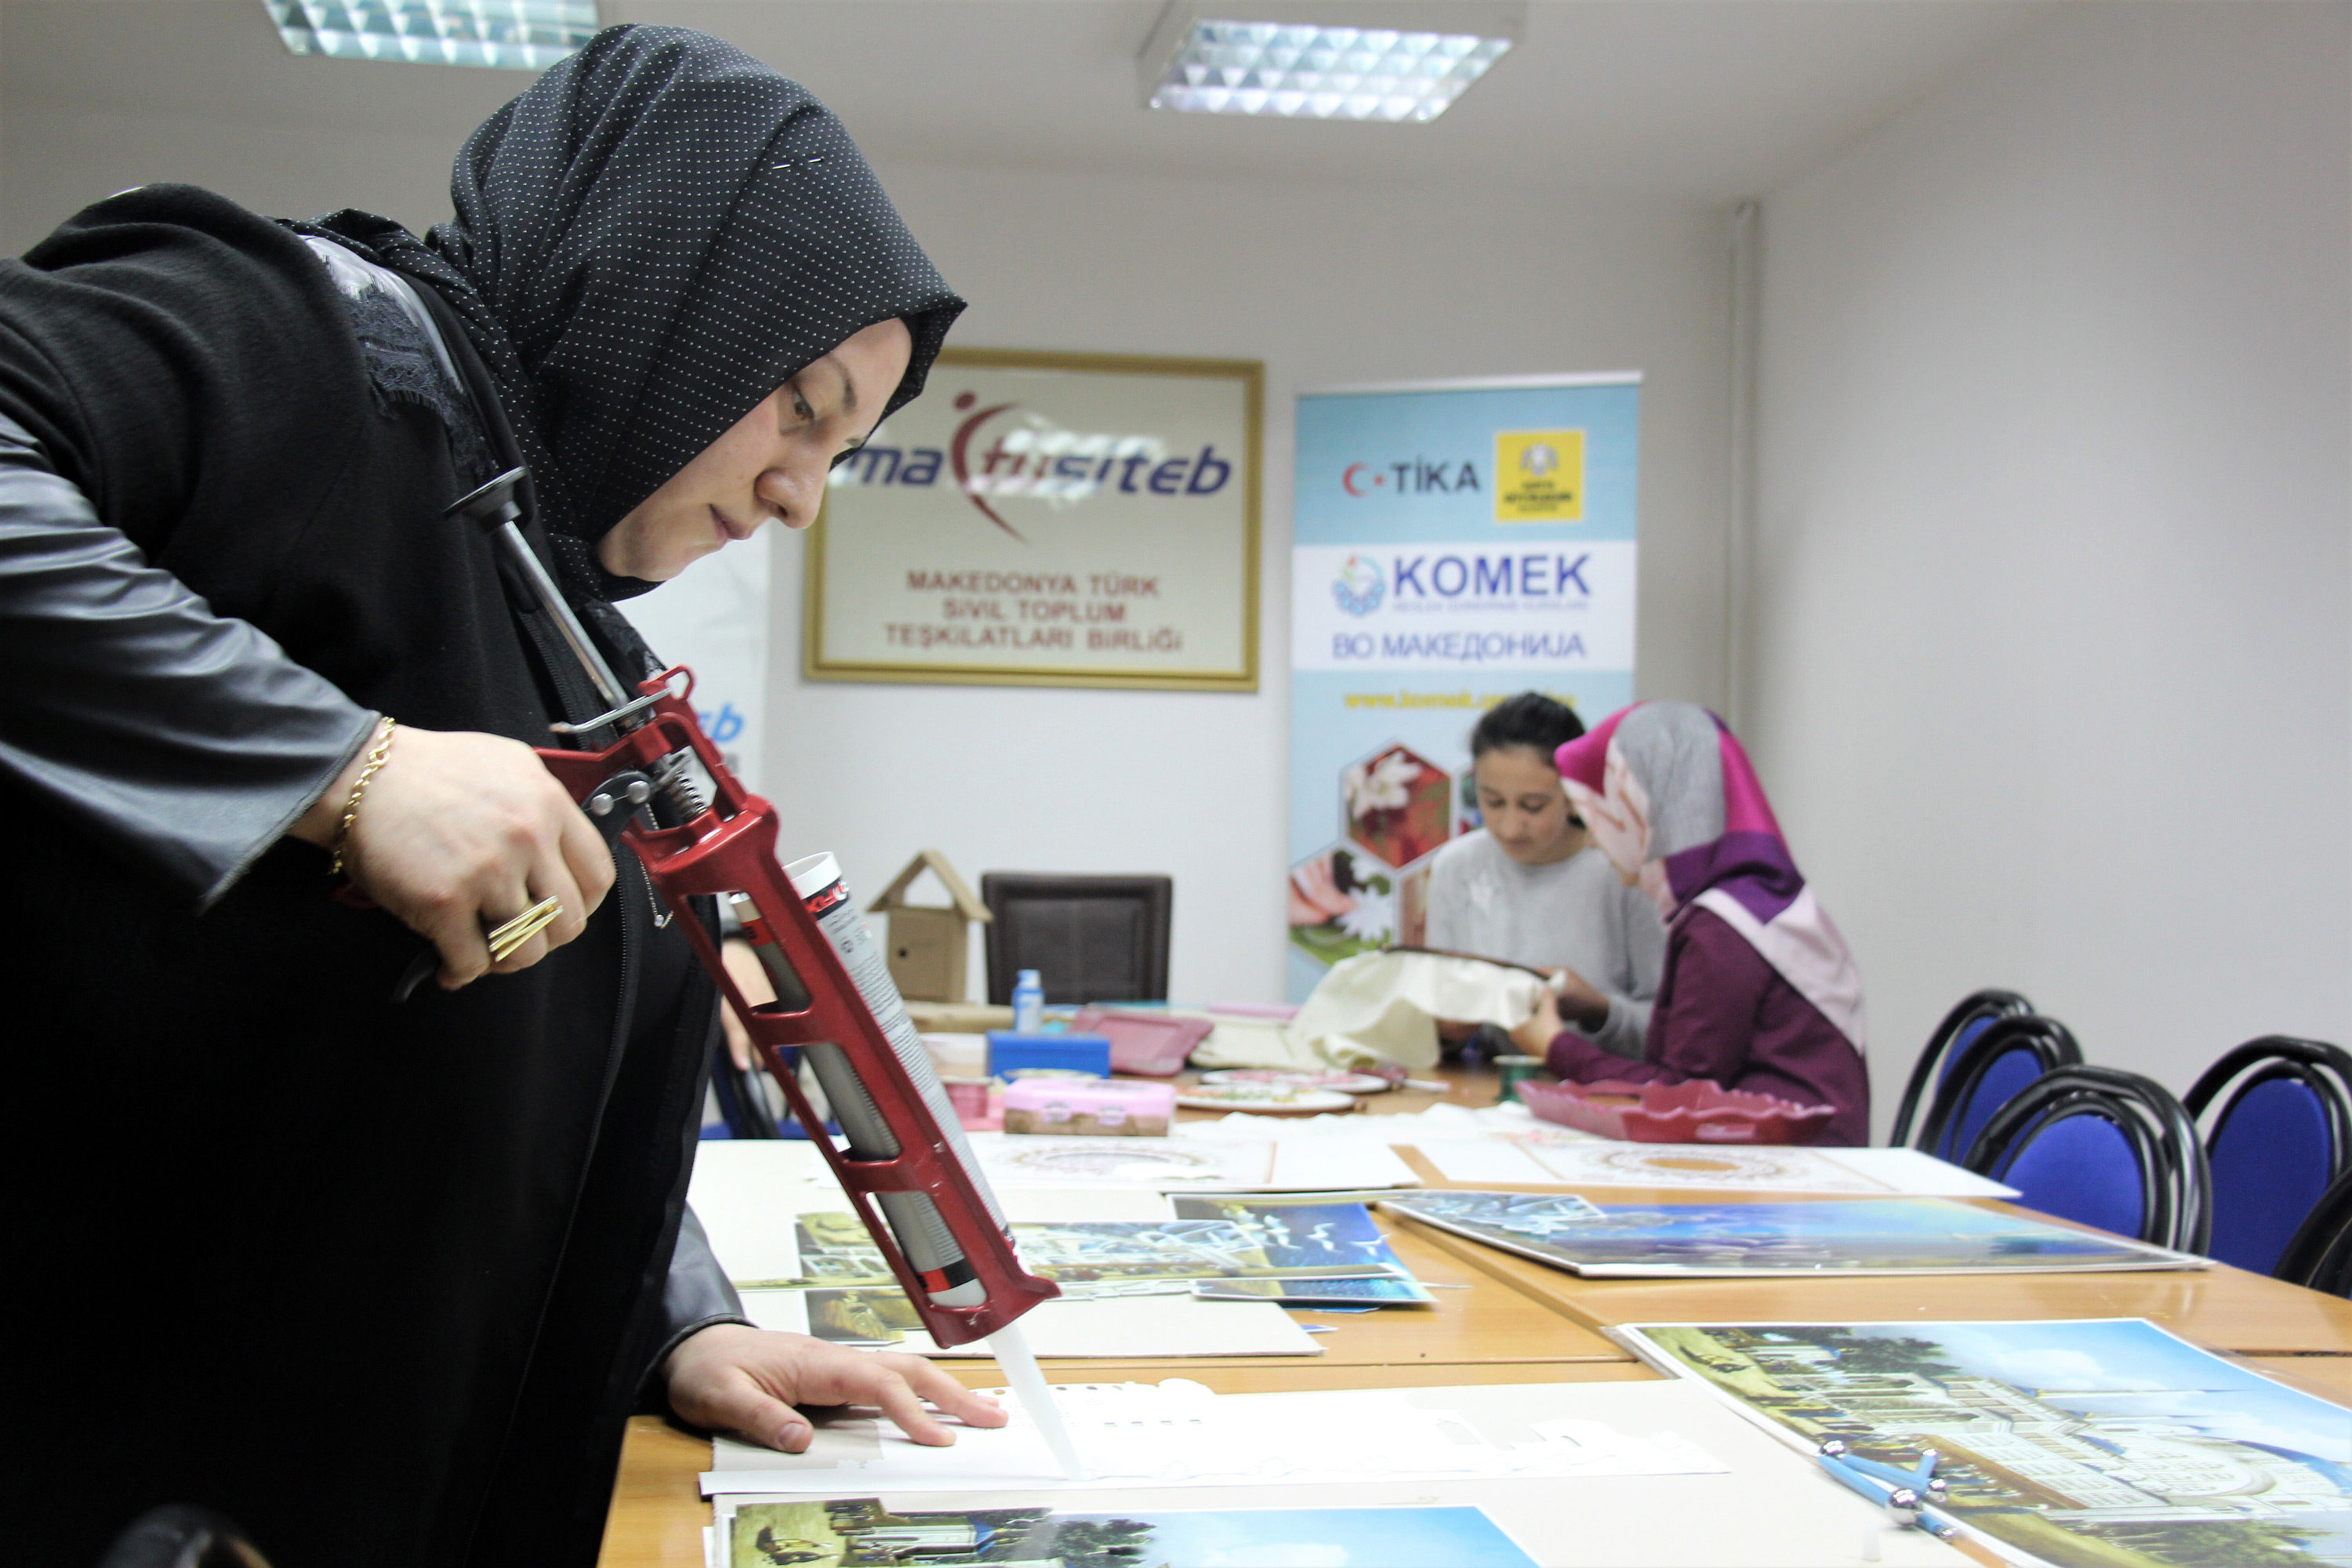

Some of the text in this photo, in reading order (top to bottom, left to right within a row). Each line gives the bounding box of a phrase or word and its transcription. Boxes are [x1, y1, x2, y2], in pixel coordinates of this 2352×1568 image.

[1389, 455, 1479, 492] TİKA
[906, 570, 1159, 597] MAKEDONYA TÜRK
[1394, 554, 1591, 596] KOMEK
[1018, 601, 1126, 622] TOPLUM
[1382, 633, 1585, 662] МАКЕДОНИЈА
